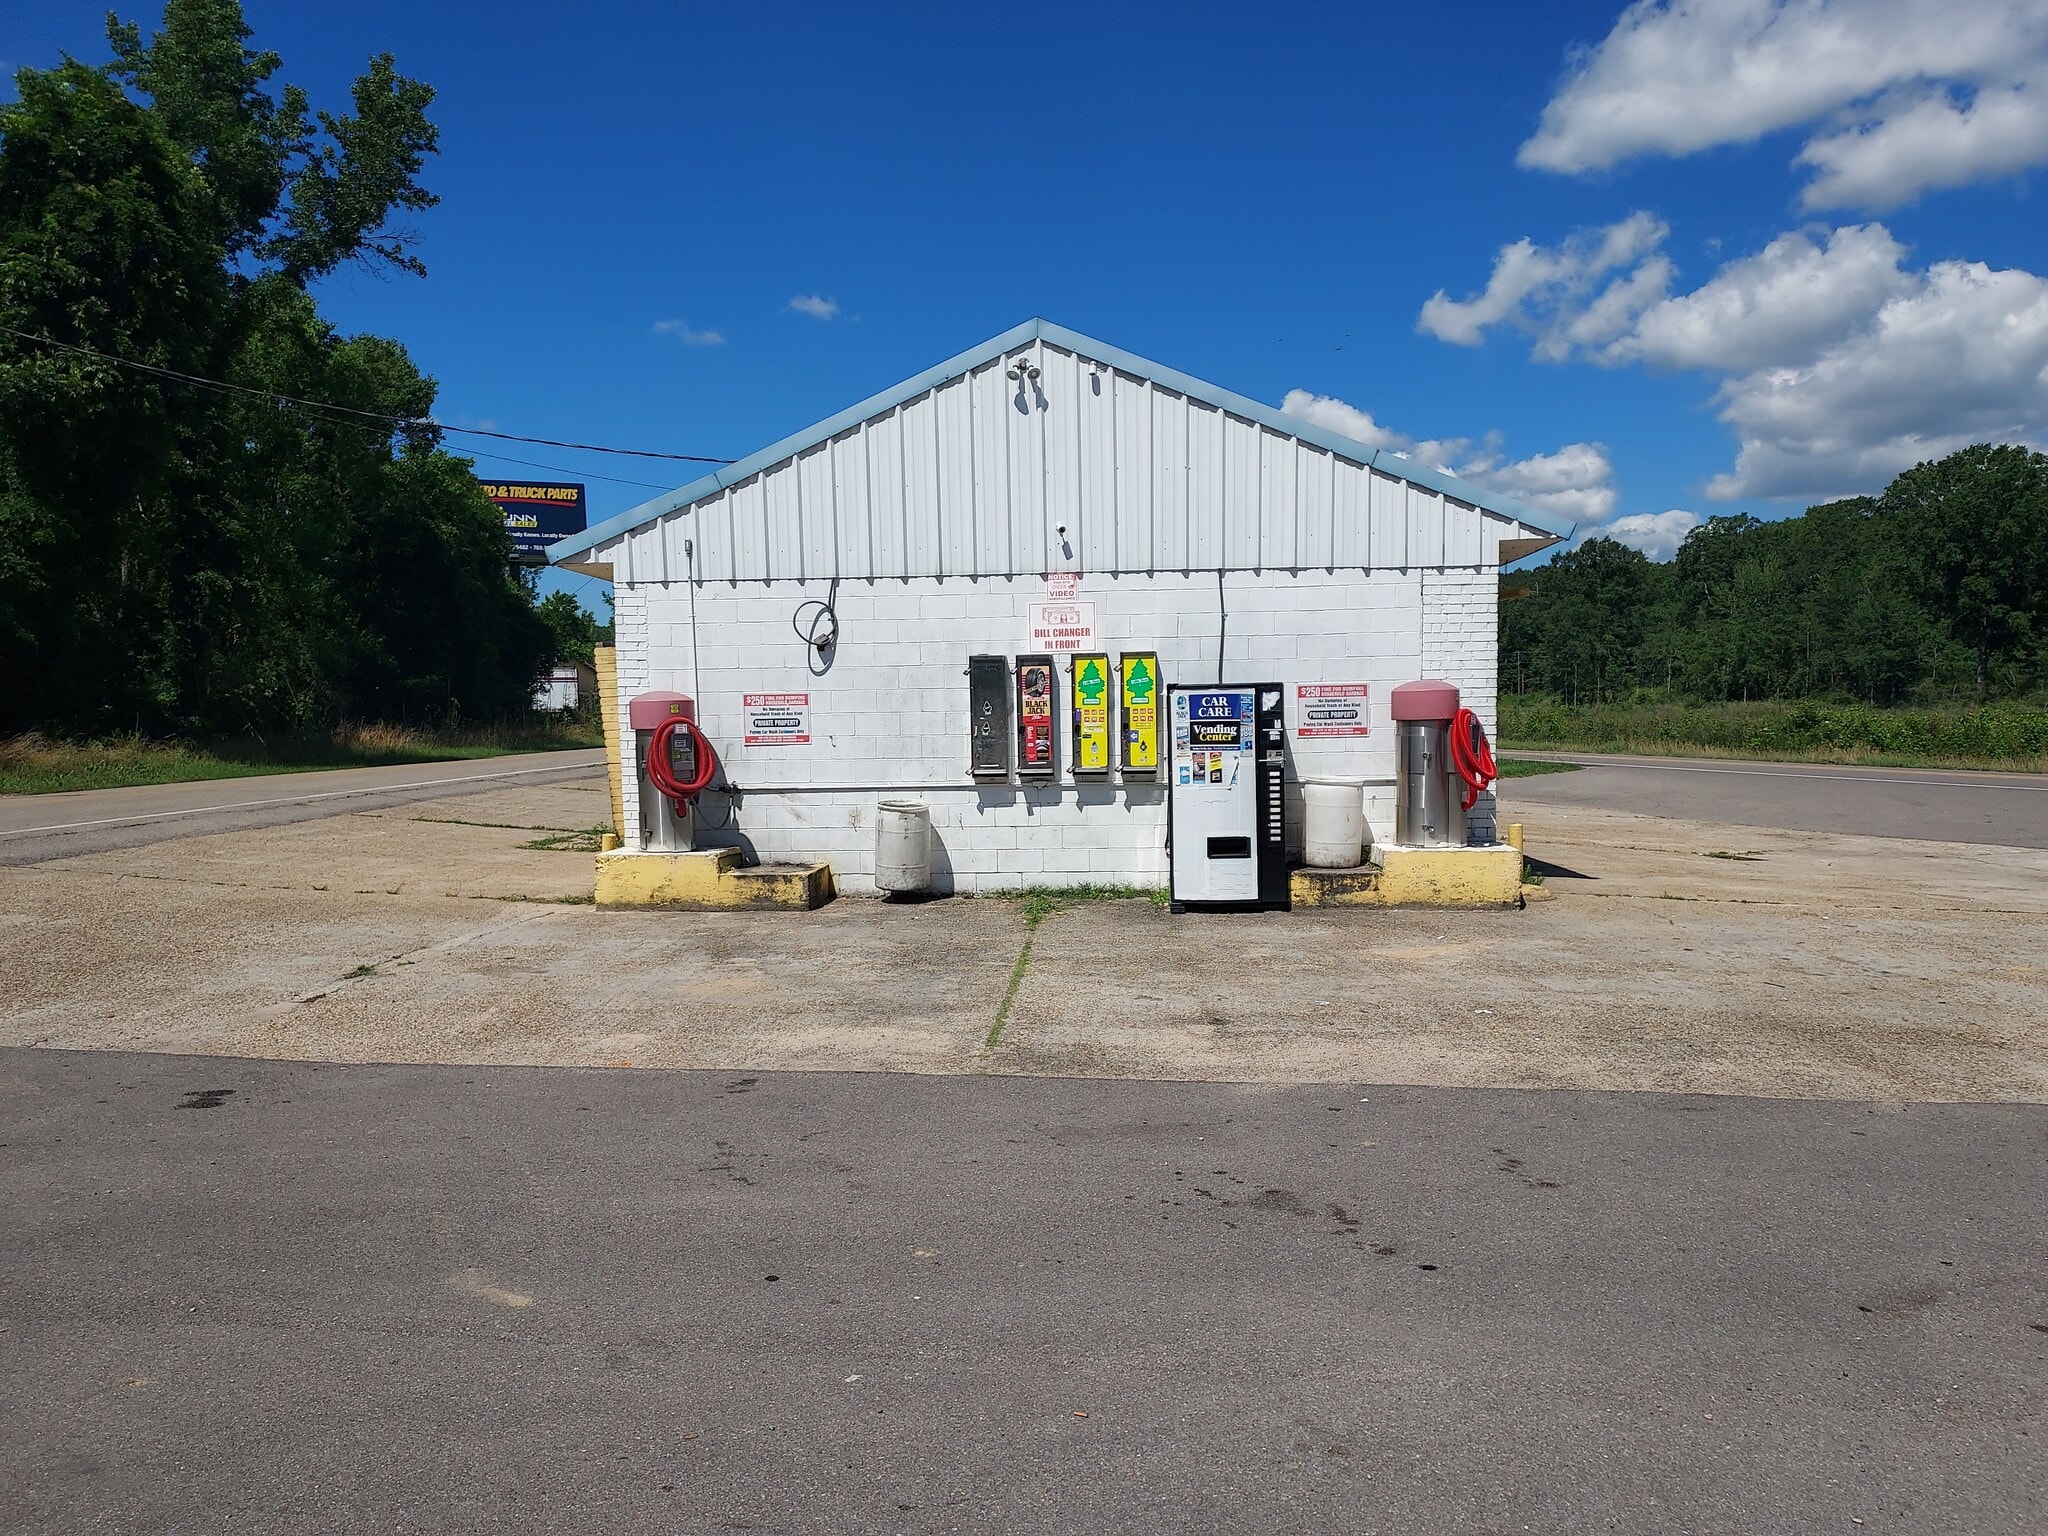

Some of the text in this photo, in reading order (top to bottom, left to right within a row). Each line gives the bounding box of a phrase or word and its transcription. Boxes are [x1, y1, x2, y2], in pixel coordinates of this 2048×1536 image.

[497, 486, 508, 497] &
[509, 486, 547, 499] TRUCK
[547, 488, 578, 500] PARTS
[1035, 628, 1090, 638] BILL CHANGER
[1045, 640, 1080, 649] IN FRONT
[1301, 687, 1320, 697] $250
[746, 696, 764, 705] $250
[1202, 697, 1228, 706] CAR
[1198, 708, 1232, 717] CARE
[1193, 724, 1237, 736] Vending
[1199, 733, 1232, 741] Center
